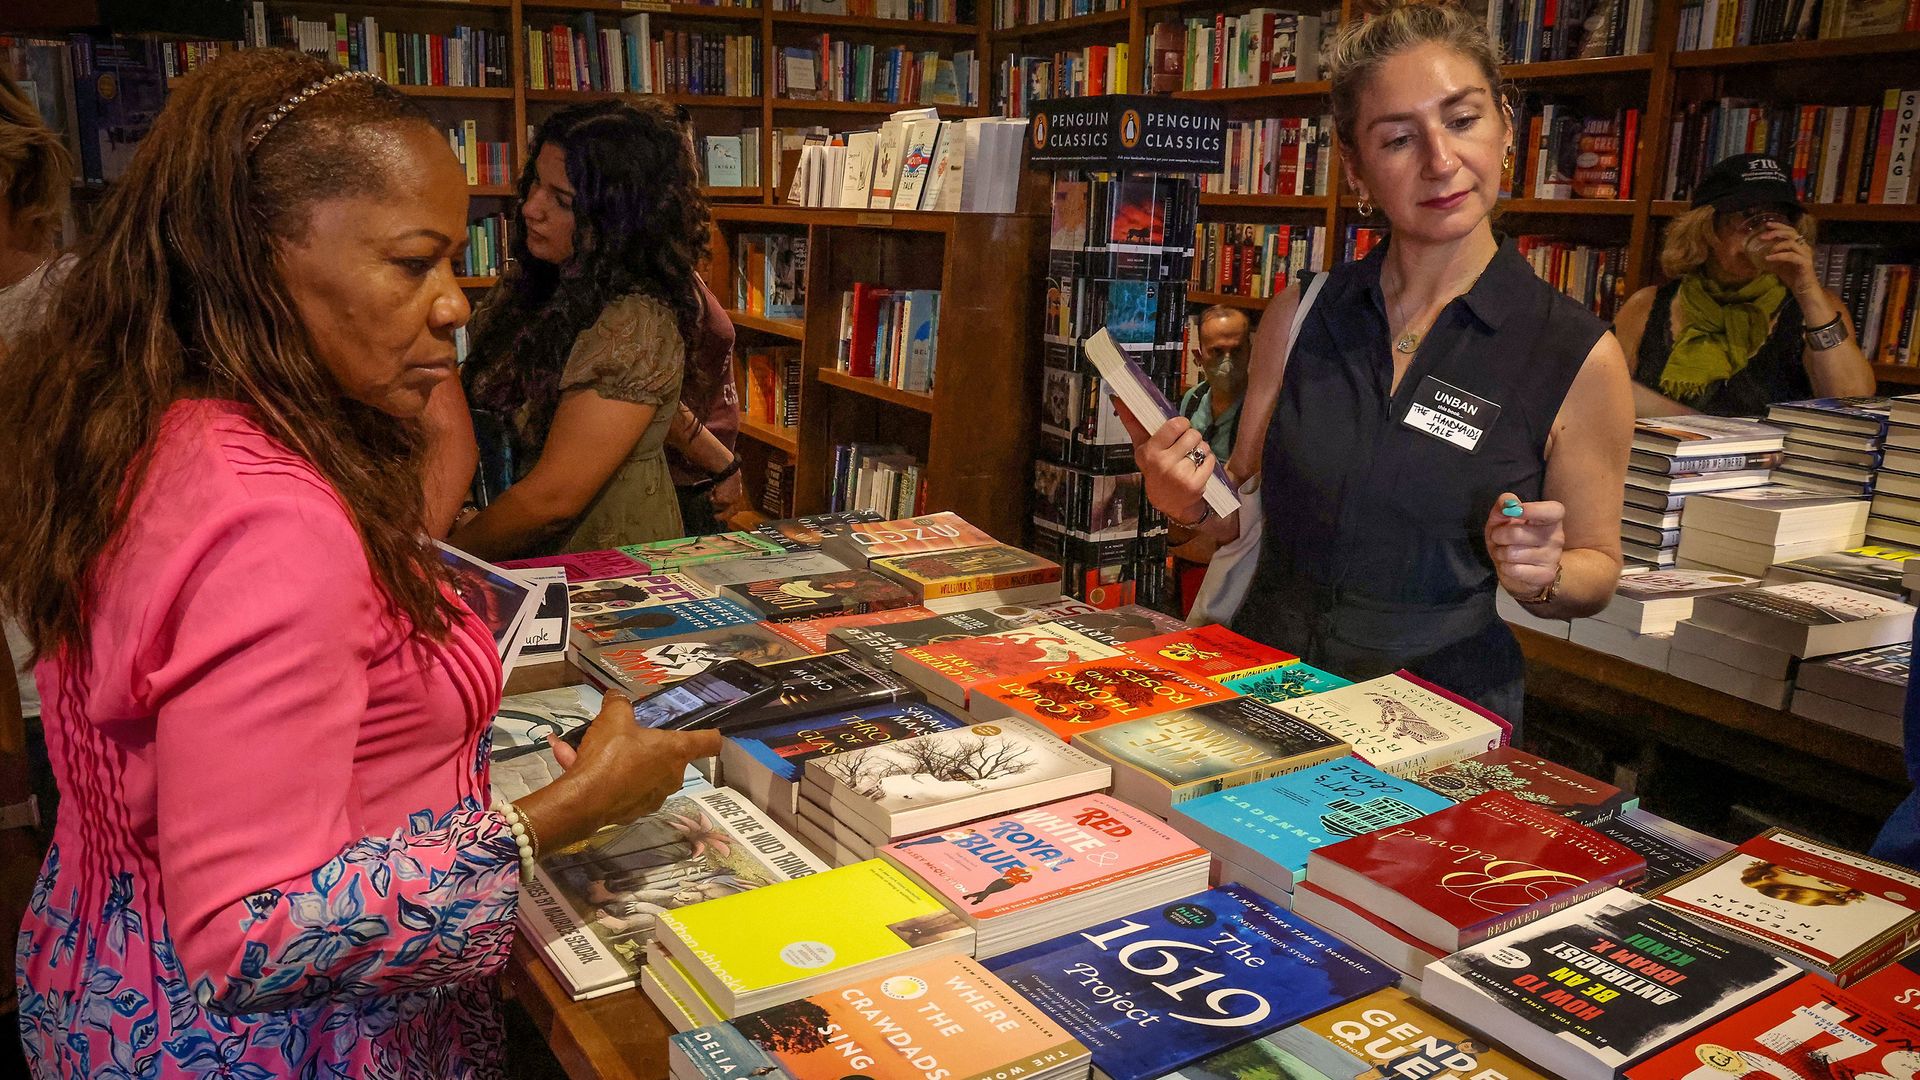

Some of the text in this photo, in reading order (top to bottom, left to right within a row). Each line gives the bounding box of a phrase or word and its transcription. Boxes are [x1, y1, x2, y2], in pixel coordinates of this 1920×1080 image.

[1214, 15, 1223, 63] LEBRON
[1051, 111, 1109, 128] PENGUIN
[1146, 113, 1221, 131] PENGUIN
[1893, 95, 1915, 176] SONTAG
[1050, 132, 1108, 148] CLASSICS
[1145, 133, 1220, 151] CLASSICS
[1748, 159, 1778, 169] FIU
[1413, 404, 1431, 416] THE
[1434, 390, 1478, 416] UNBAN
[1426, 422, 1455, 438] TALE
[1679, 456, 1745, 472] LOOK FOR ME THERE
[632, 575, 700, 601] PET
[665, 604, 708, 630] DAUGHTER
[680, 601, 727, 626] MEXICAN
[701, 599, 745, 624] PERFECT
[523, 632, 549, 646] urple
[845, 628, 893, 652] NGER
[1056, 619, 1126, 646] PURPLE
[906, 648, 964, 676] CATCHER
[943, 653, 974, 668] RYE
[1126, 656, 1219, 697] SARAH MAAS
[789, 669, 833, 691] CROW
[1049, 670, 1139, 716] THORNS
[1085, 670, 1120, 685] AND
[1115, 669, 1192, 705] ROSES
[997, 682, 1068, 713] COURT
[1069, 700, 1095, 710] OF
[840, 714, 897, 743] THRO
[908, 706, 951, 731] SARAH
[1288, 703, 1382, 755] SALMAN
[1298, 698, 1403, 753] RUSHDIE
[797, 729, 844, 754] GLAS
[840, 733, 863, 744] OF
[1330, 765, 1404, 795] CRADLE
[1511, 759, 1598, 794] HARPER LEE
[701, 790, 731, 821] WHERE
[731, 814, 754, 840] THE
[753, 829, 784, 860] WILD
[1013, 810, 1107, 853] WHITE
[1222, 795, 1322, 844] ONNEGUT
[1479, 801, 1611, 865] Toni Morrison
[988, 820, 1077, 872] ROYAL
[1605, 828, 1671, 862] BALDWIN
[1377, 828, 1590, 915] Beloved
[1176, 905, 1204, 925] hulu
[1486, 909, 1541, 938] BELOVED
[1549, 897, 1572, 914] Toni
[1696, 897, 1816, 941] DREAMING
[1712, 893, 1787, 921] CUBAN
[545, 903, 575, 937] MAURICE
[568, 930, 603, 965] SENDAK
[1208, 931, 1266, 969] The
[1238, 918, 1255, 930] NEW
[1256, 929, 1289, 950] ORIGIN
[1289, 946, 1318, 966] STORY
[1241, 897, 1262, 911] NEW
[1262, 909, 1290, 930] YORK
[1291, 928, 1325, 949] TIMES
[1325, 946, 1372, 975] bestseller
[1623, 932, 1697, 968] KENDI
[1080, 919, 1271, 1028] 1619
[1471, 971, 1519, 997] BESTSELLER
[1542, 942, 1682, 1006] ANTIRACIST
[1609, 949, 1688, 987] IBRAM
[962, 963, 976, 975] NEW
[976, 973, 992, 987] YORK
[992, 986, 1012, 1005] TIMES
[1012, 1003, 1053, 1038] BESTSELLER
[1063, 962, 1161, 1029] Project
[1512, 973, 1606, 1021] HOW TO
[1547, 966, 1621, 1004] BE AN
[917, 1001, 965, 1038] THE
[944, 974, 1021, 1033] WHERE
[1520, 996, 1547, 1012] TIMES
[1550, 1011, 1571, 1024] YORK
[840, 987, 951, 1080] CRAWDADS
[1574, 1023, 1592, 1035] NEW
[1800, 1008, 1873, 1047] ANNIVERSARY
[692, 1030, 738, 1074] DELIA
[817, 1022, 876, 1071] SING
[1033, 1048, 1070, 1067] THE
[1333, 1038, 1365, 1057] MEMOIR
